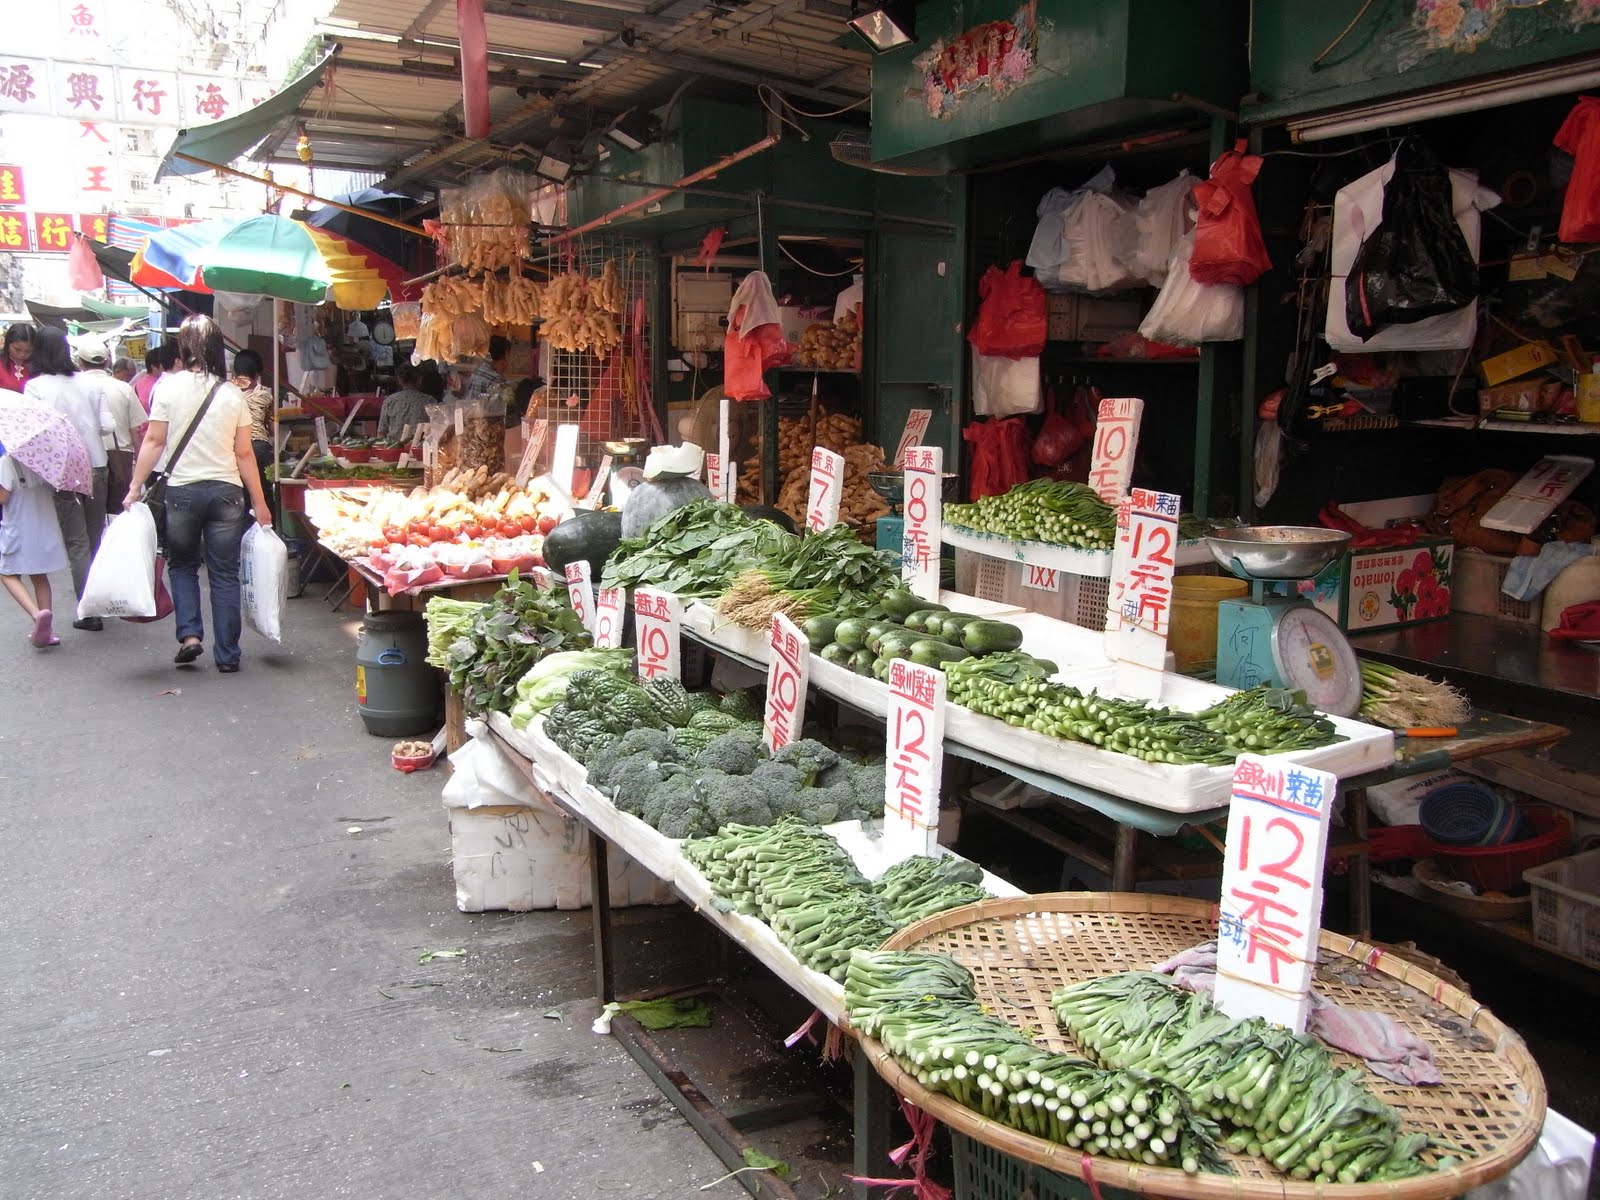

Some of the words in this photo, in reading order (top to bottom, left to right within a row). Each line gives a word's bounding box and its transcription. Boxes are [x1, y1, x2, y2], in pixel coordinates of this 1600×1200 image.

[0, 63, 277, 120] 源興行海
[904, 448, 934, 469] 新界
[1096, 426, 1126, 461] 10
[811, 449, 834, 474] 新界
[813, 477, 830, 507] 7
[1131, 522, 1173, 566] 12
[1354, 572, 1395, 589] tomato
[634, 591, 670, 617] 新界
[641, 624, 669, 660] 10
[771, 661, 797, 713] 10
[895, 706, 930, 762] 12
[1238, 815, 1311, 889] 12
